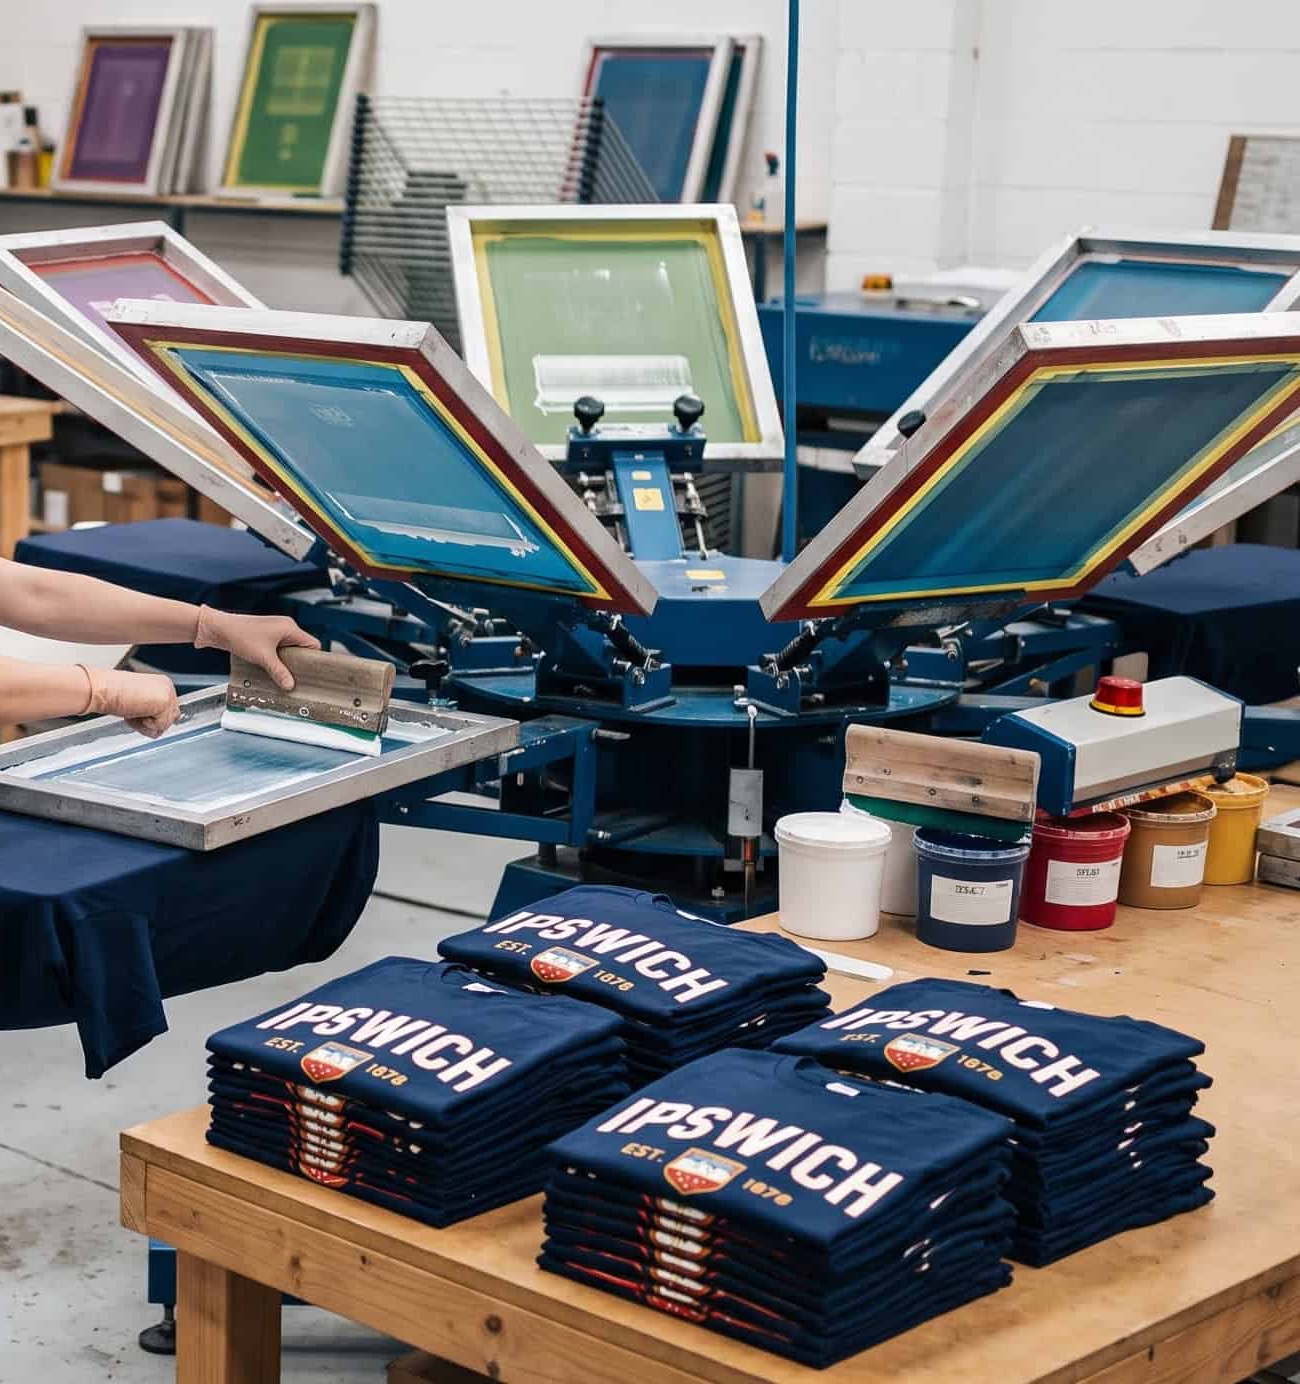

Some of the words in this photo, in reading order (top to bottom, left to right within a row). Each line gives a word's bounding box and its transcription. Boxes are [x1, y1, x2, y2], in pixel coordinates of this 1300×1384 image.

[482, 911, 730, 1004] IPSWICH
[494, 940, 532, 955] EST.
[255, 1002, 513, 1093] IPSWICH
[264, 1036, 304, 1053] EST.
[820, 1008, 1101, 1097] IPSWICH
[596, 1097, 904, 1218] IPSWICH
[620, 1142, 666, 1163] EST.
